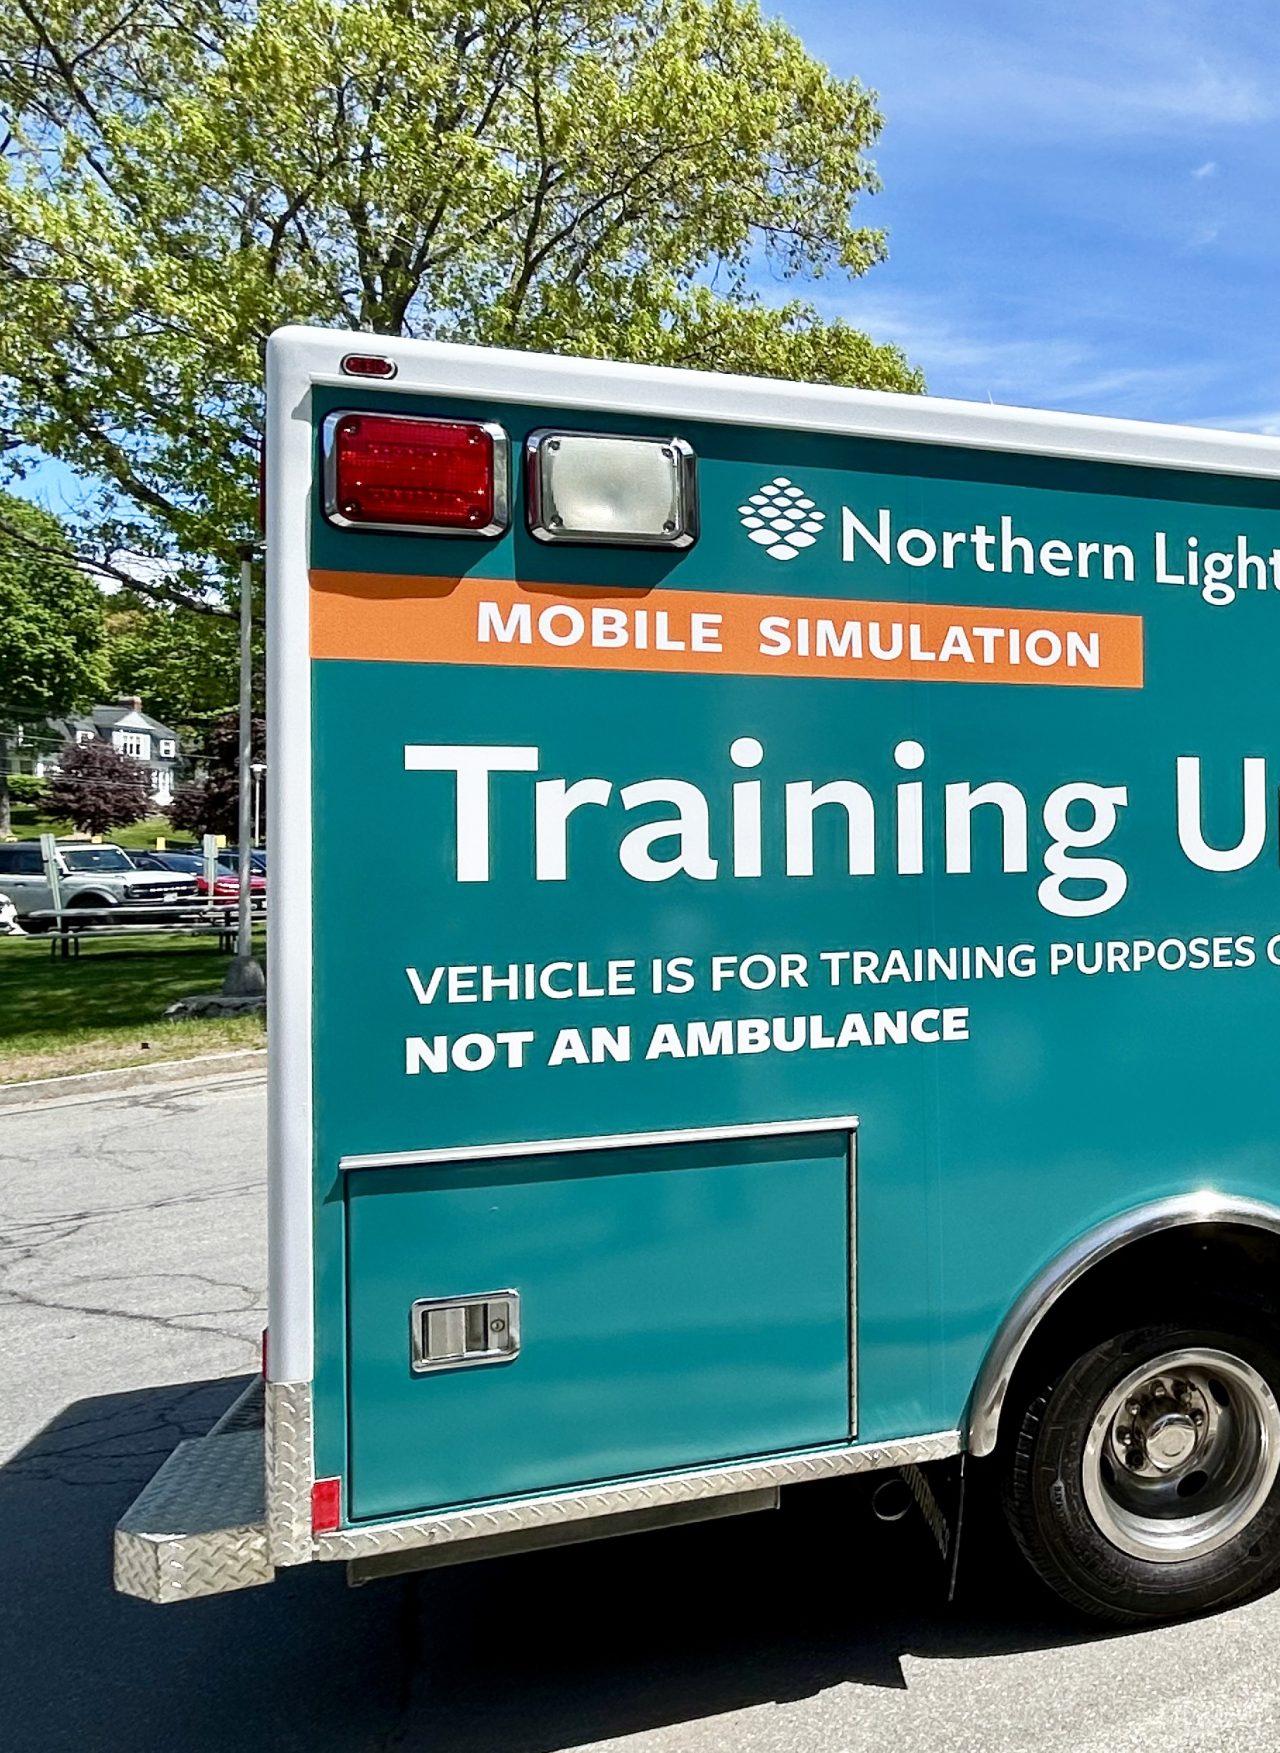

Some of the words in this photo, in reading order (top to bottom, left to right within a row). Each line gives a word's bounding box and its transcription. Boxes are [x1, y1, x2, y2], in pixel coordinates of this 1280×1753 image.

[842, 506, 1134, 581] Northern
[477, 601, 723, 653] MOBILE
[759, 616, 1100, 668] SIMULATION
[404, 737, 1128, 917] Training
[405, 959, 636, 1005] VEHICLE
[652, 957, 695, 994] IS
[712, 953, 809, 992] FOR
[819, 944, 1036, 986] TRAINING
[1050, 935, 1256, 975] PURPOSES
[406, 1031, 534, 1075] NOT
[547, 1025, 631, 1066] AN
[645, 1007, 969, 1060] AMBULANCE
